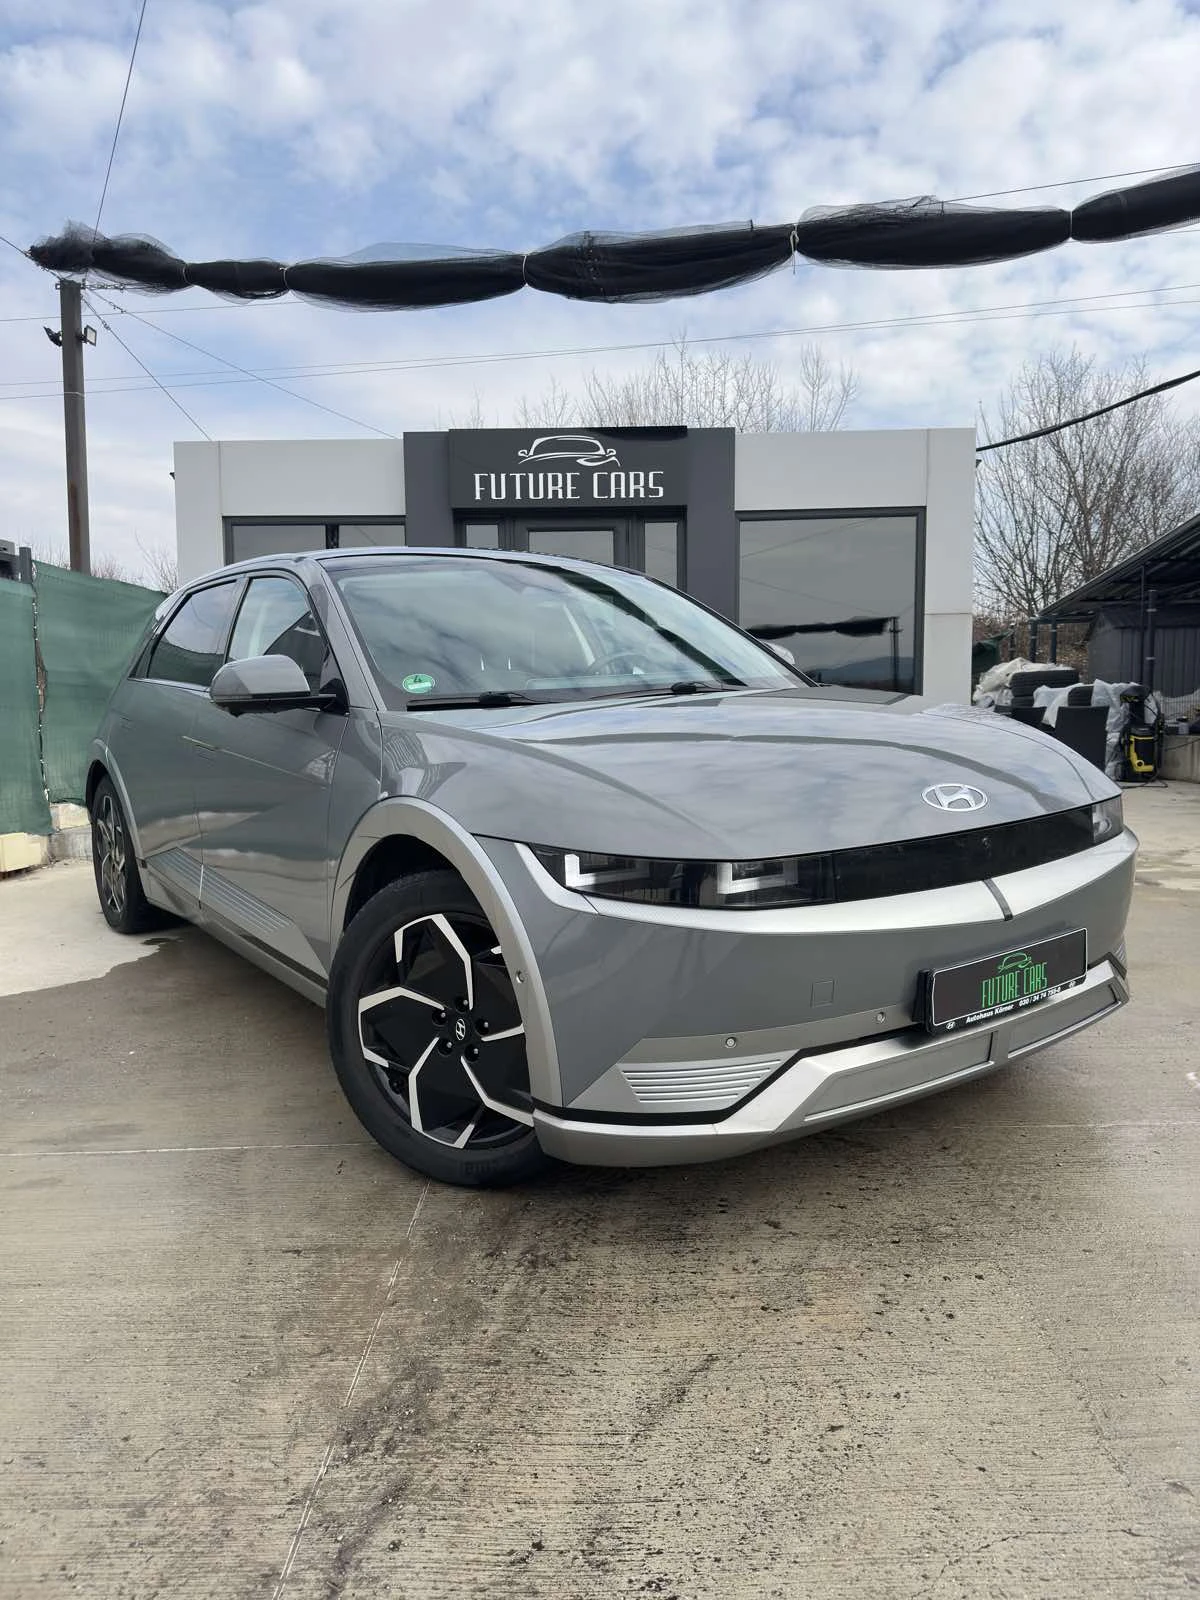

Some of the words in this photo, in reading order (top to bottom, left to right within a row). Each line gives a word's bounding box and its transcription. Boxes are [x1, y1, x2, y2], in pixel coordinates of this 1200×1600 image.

[473, 472, 580, 500] FUTURE
[592, 471, 664, 499] CARS
[981, 970, 1021, 1009] FUTURE
[1023, 961, 1048, 995] CARS
[965, 1010, 994, 1024] Autohaus
